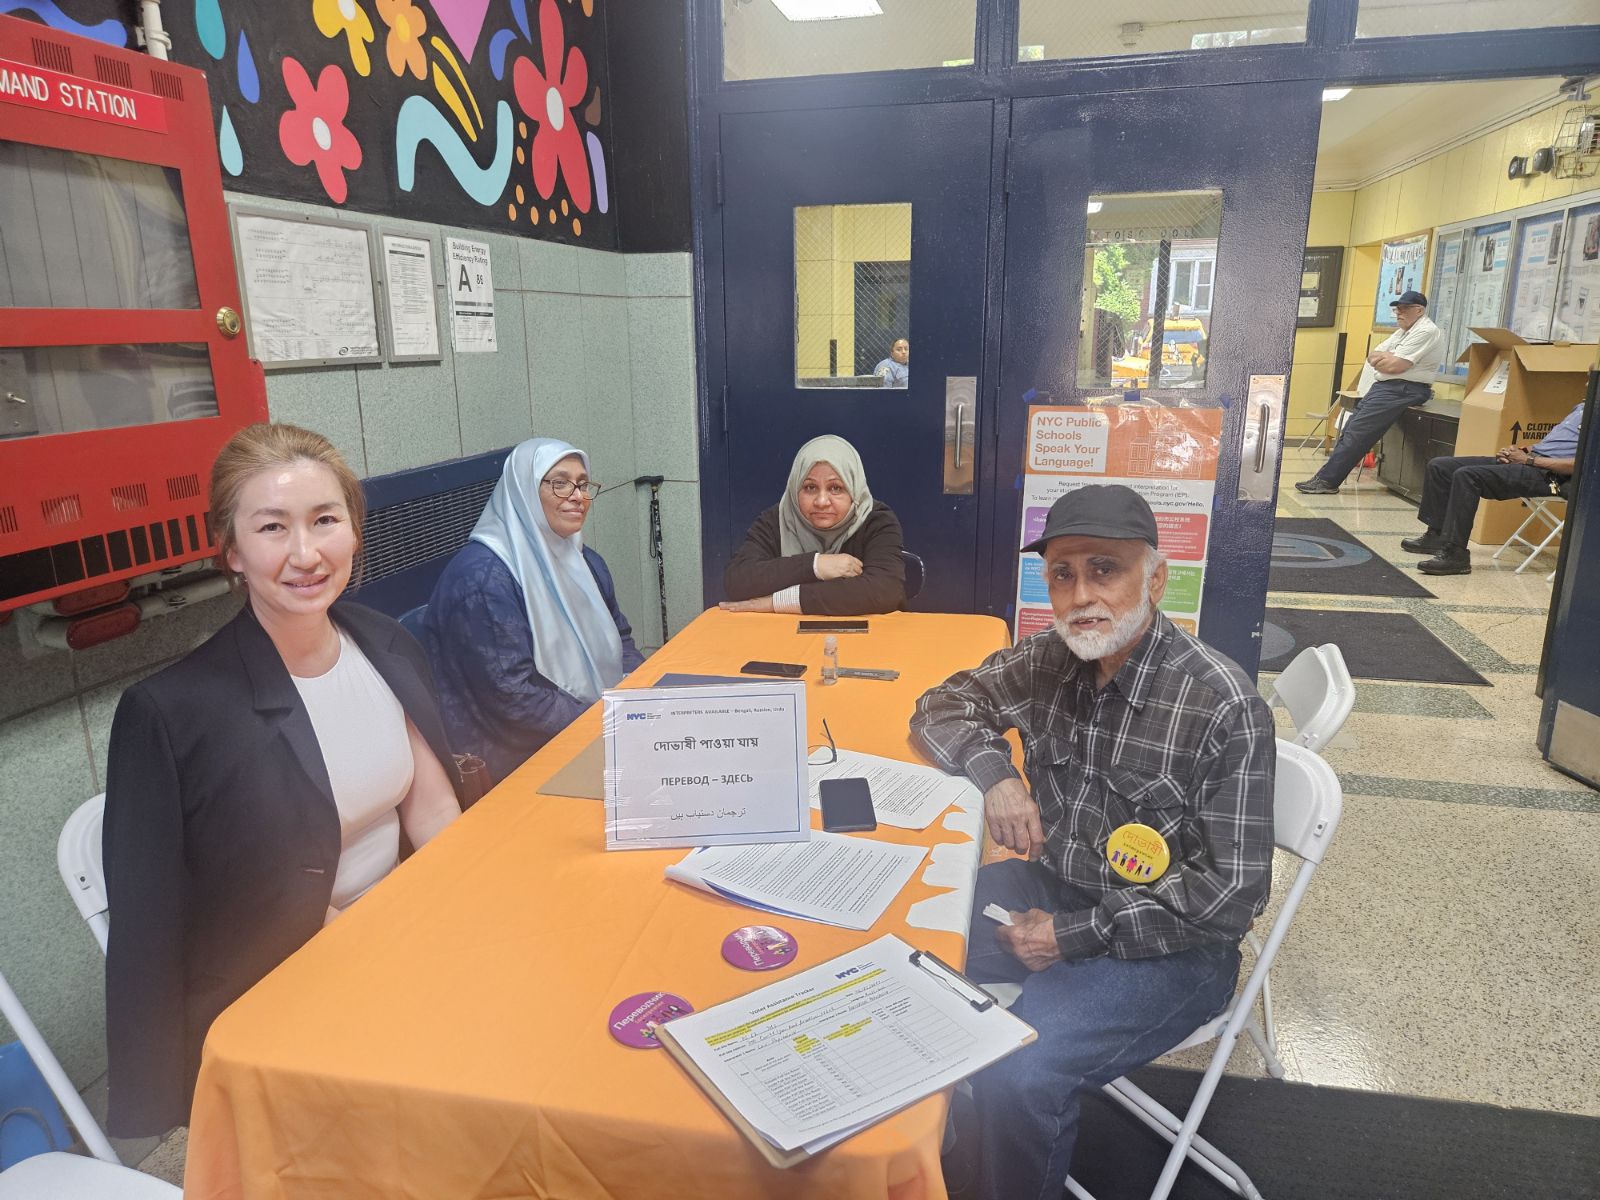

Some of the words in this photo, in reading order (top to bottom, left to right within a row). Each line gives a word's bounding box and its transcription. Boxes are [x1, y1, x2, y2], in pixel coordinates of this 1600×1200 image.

[59, 81, 137, 120] STATION
[452, 241, 471, 254] Building
[471, 244, 486, 256] Energy
[452, 252, 474, 264] Efficiency
[474, 255, 488, 266] Rating
[458, 264, 473, 293] A
[1037, 416, 1063, 427] NYC
[1066, 417, 1102, 428] Public
[1526, 423, 1559, 432] CLOTH
[1036, 430, 1082, 441] Schools
[1035, 443, 1071, 455] Speak
[1073, 444, 1100, 455] Your
[1034, 457, 1094, 469] Language!
[626, 713, 647, 721] NYC
[653, 736, 696, 752] দোভাষী
[699, 738, 735, 750] পাওয়া
[661, 775, 709, 787] ПЕРЕВОД
[720, 773, 754, 785] ЗДЕСЬ
[835, 967, 860, 980] NYC
